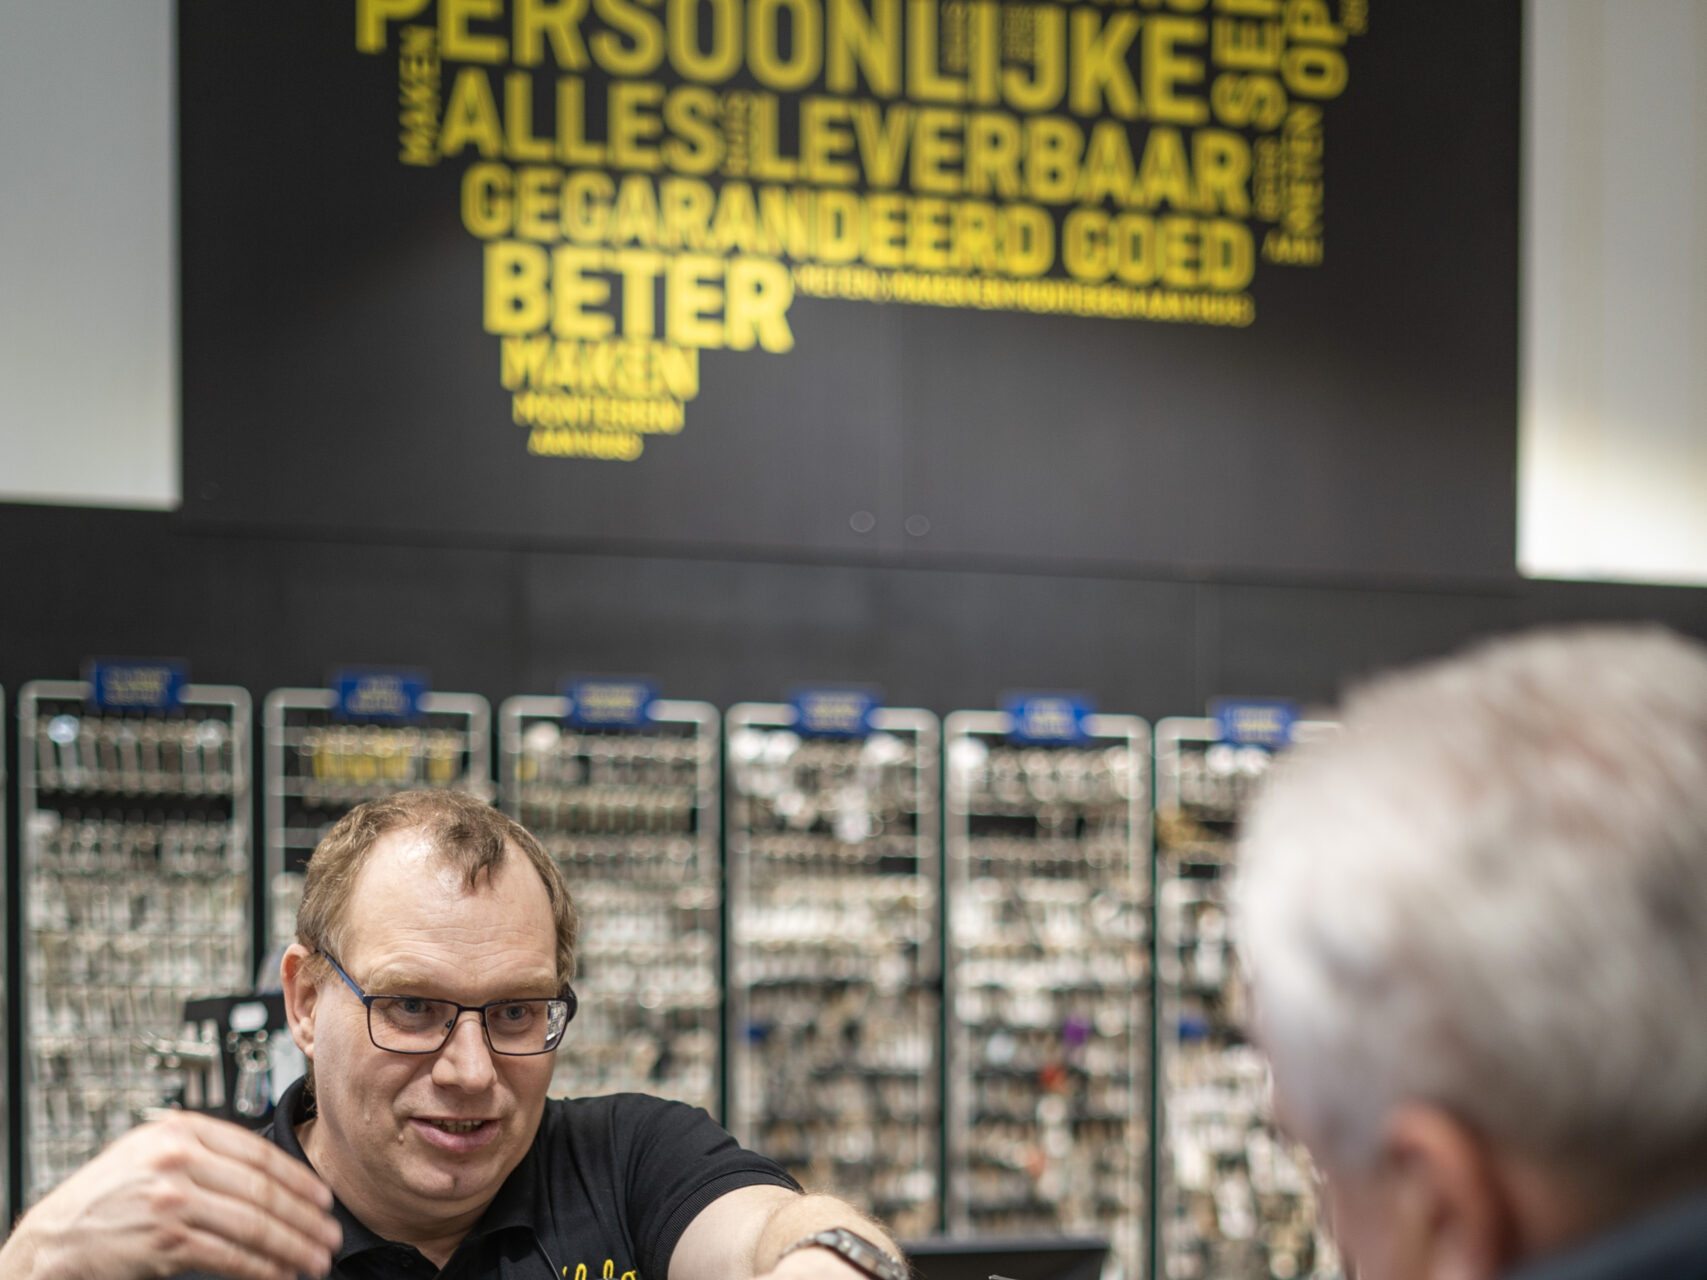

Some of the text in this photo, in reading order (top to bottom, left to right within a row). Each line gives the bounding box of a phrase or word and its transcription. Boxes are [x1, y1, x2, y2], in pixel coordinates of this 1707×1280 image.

[440, 67, 727, 176] ALLES
[752, 91, 1254, 219] LEVERBAAR
[460, 161, 1056, 279] GEGARANDEERD
[1061, 206, 1256, 292] GOED
[482, 240, 796, 354] BETER
